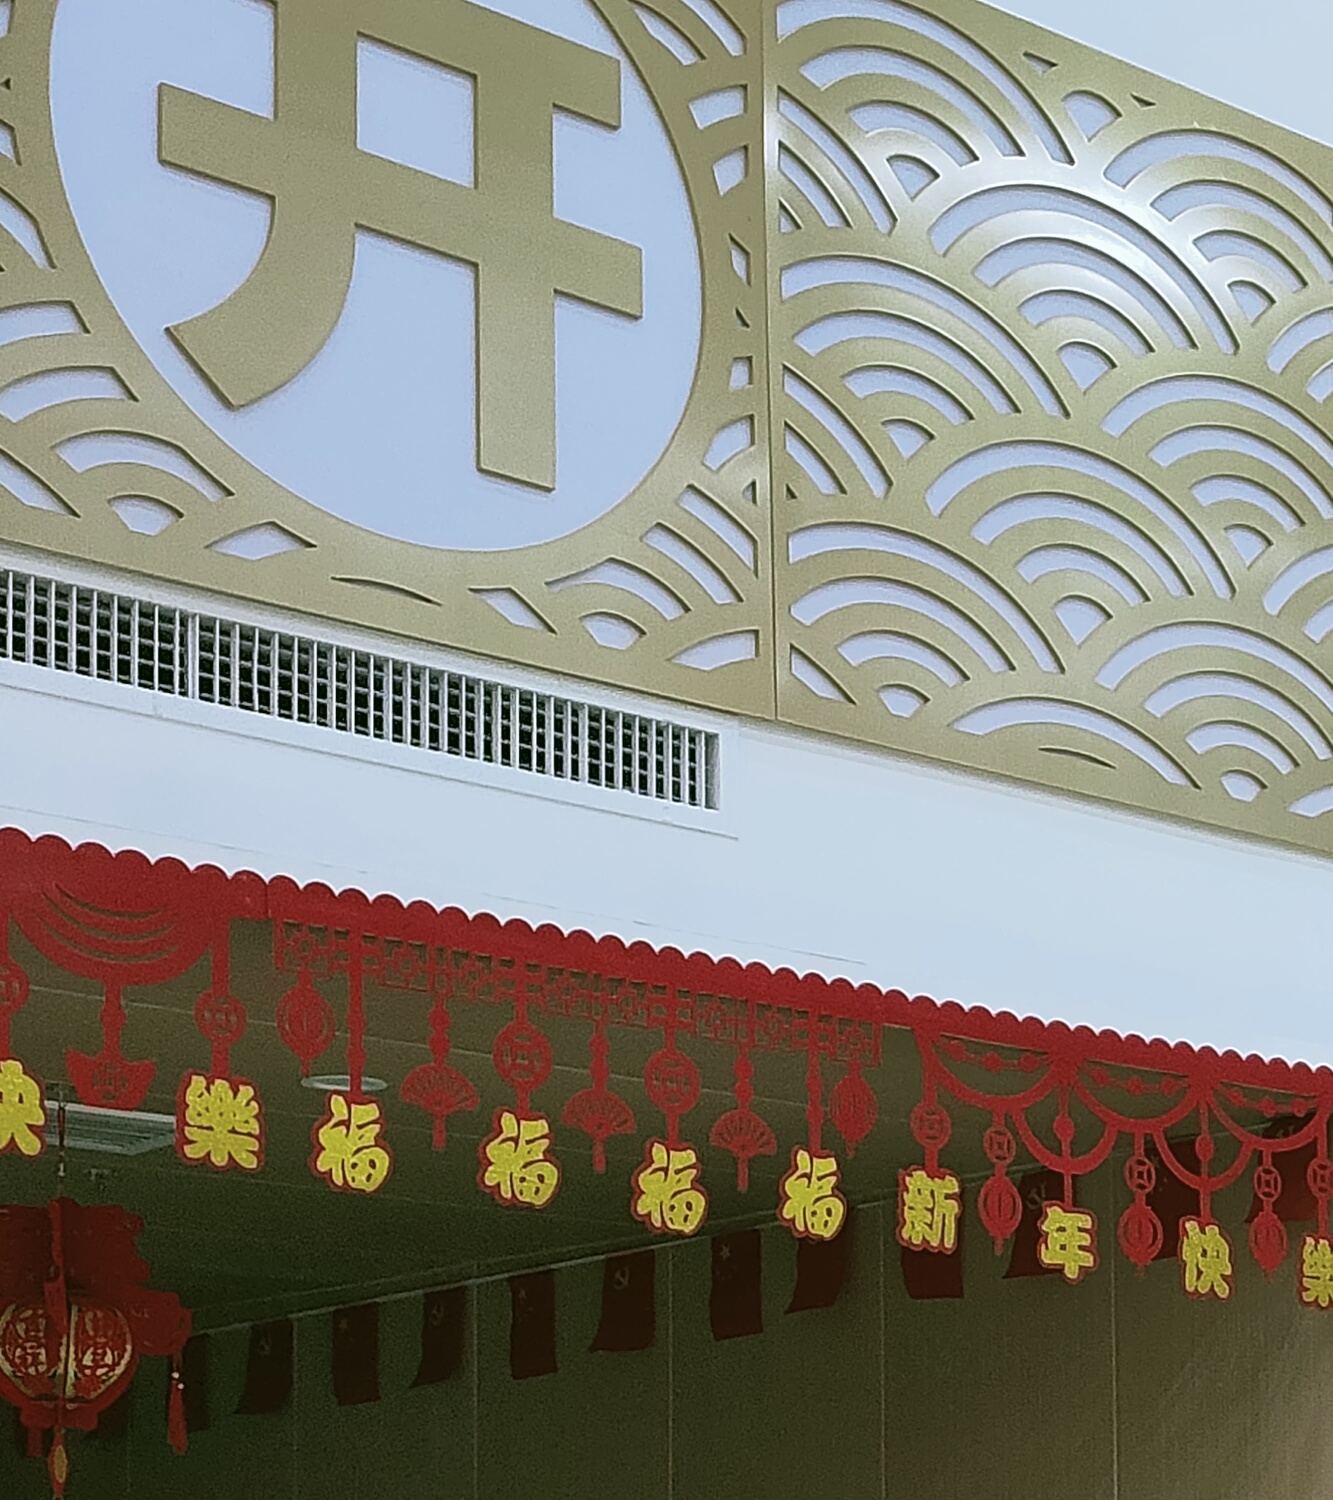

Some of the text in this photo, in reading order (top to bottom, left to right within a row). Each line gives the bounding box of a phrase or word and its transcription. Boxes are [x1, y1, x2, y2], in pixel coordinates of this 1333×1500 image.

[158, 0, 643, 492] 开
[185, 1074, 261, 1169] 樂
[317, 1095, 846, 1237] 福 福 福 福
[902, 1170, 960, 1249] 新
[1040, 1205, 1094, 1279] 年
[1182, 1220, 1232, 1298] 快
